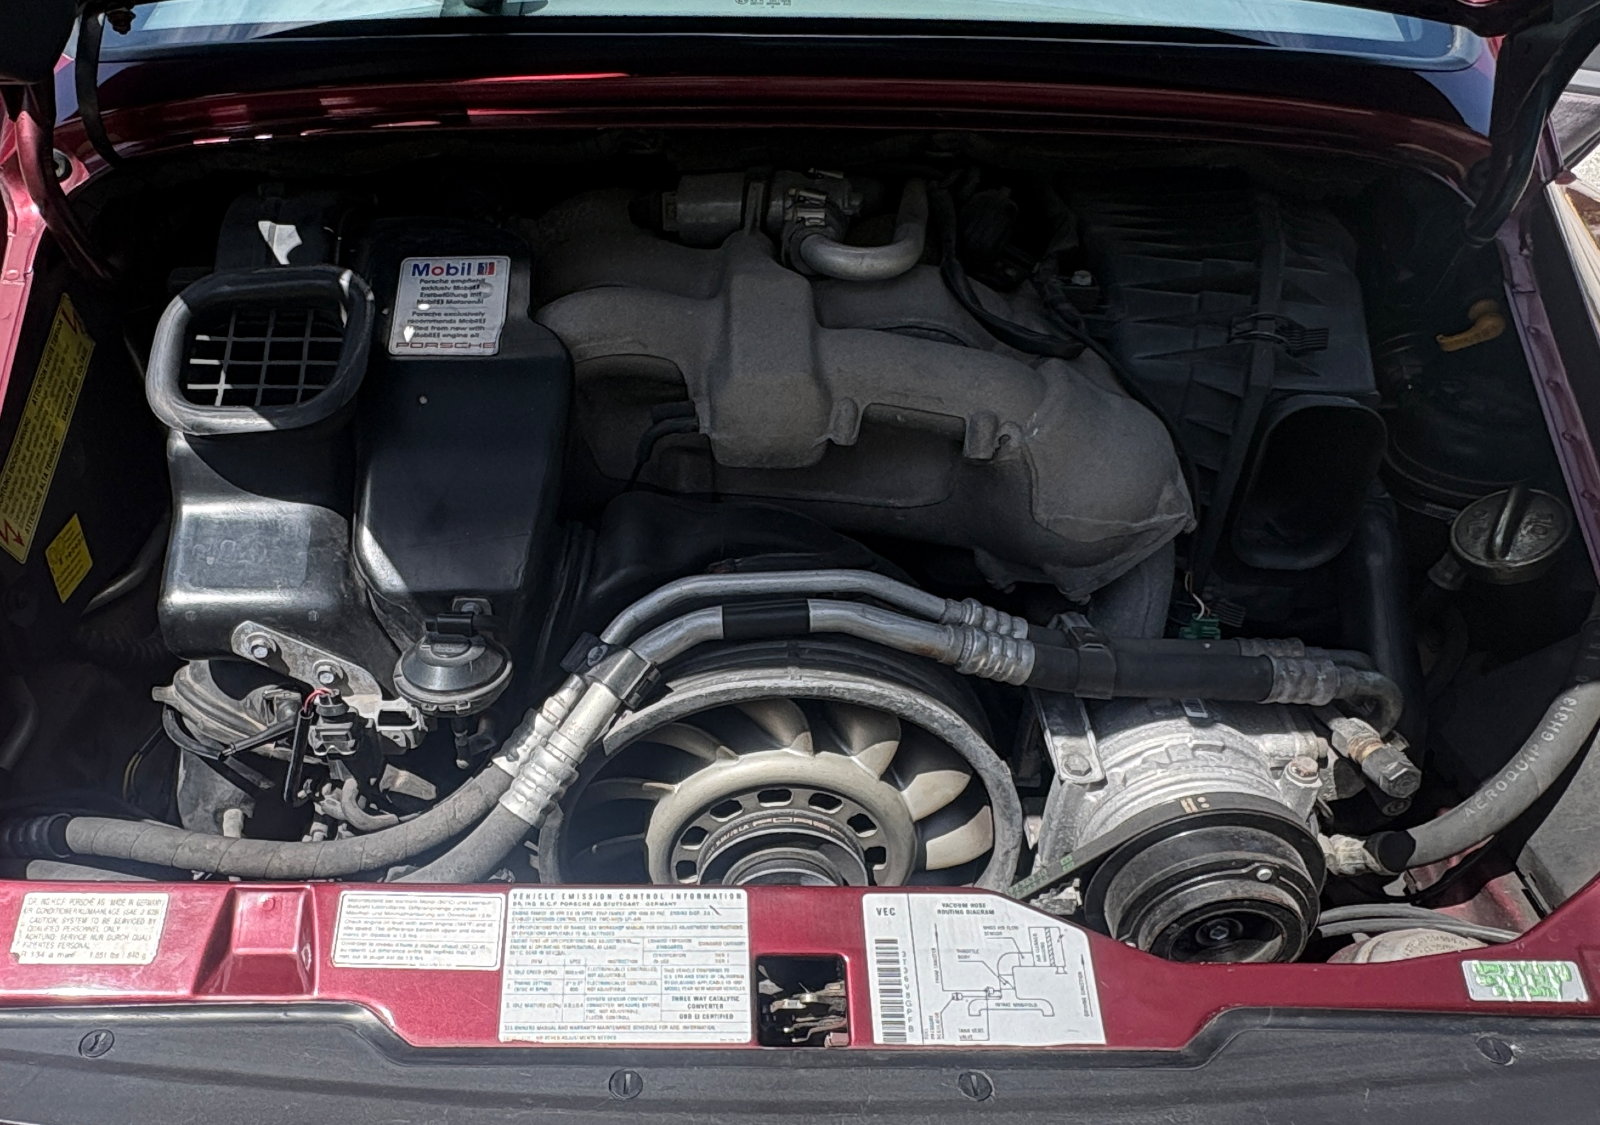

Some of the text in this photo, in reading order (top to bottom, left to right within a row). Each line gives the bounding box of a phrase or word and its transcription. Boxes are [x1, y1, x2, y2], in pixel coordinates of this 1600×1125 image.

[412, 263, 472, 277] Mobil
[32, 371, 48, 406] ATTENTION
[1462, 743, 1541, 818] AEROQUIP
[876, 907, 896, 916] VEC
